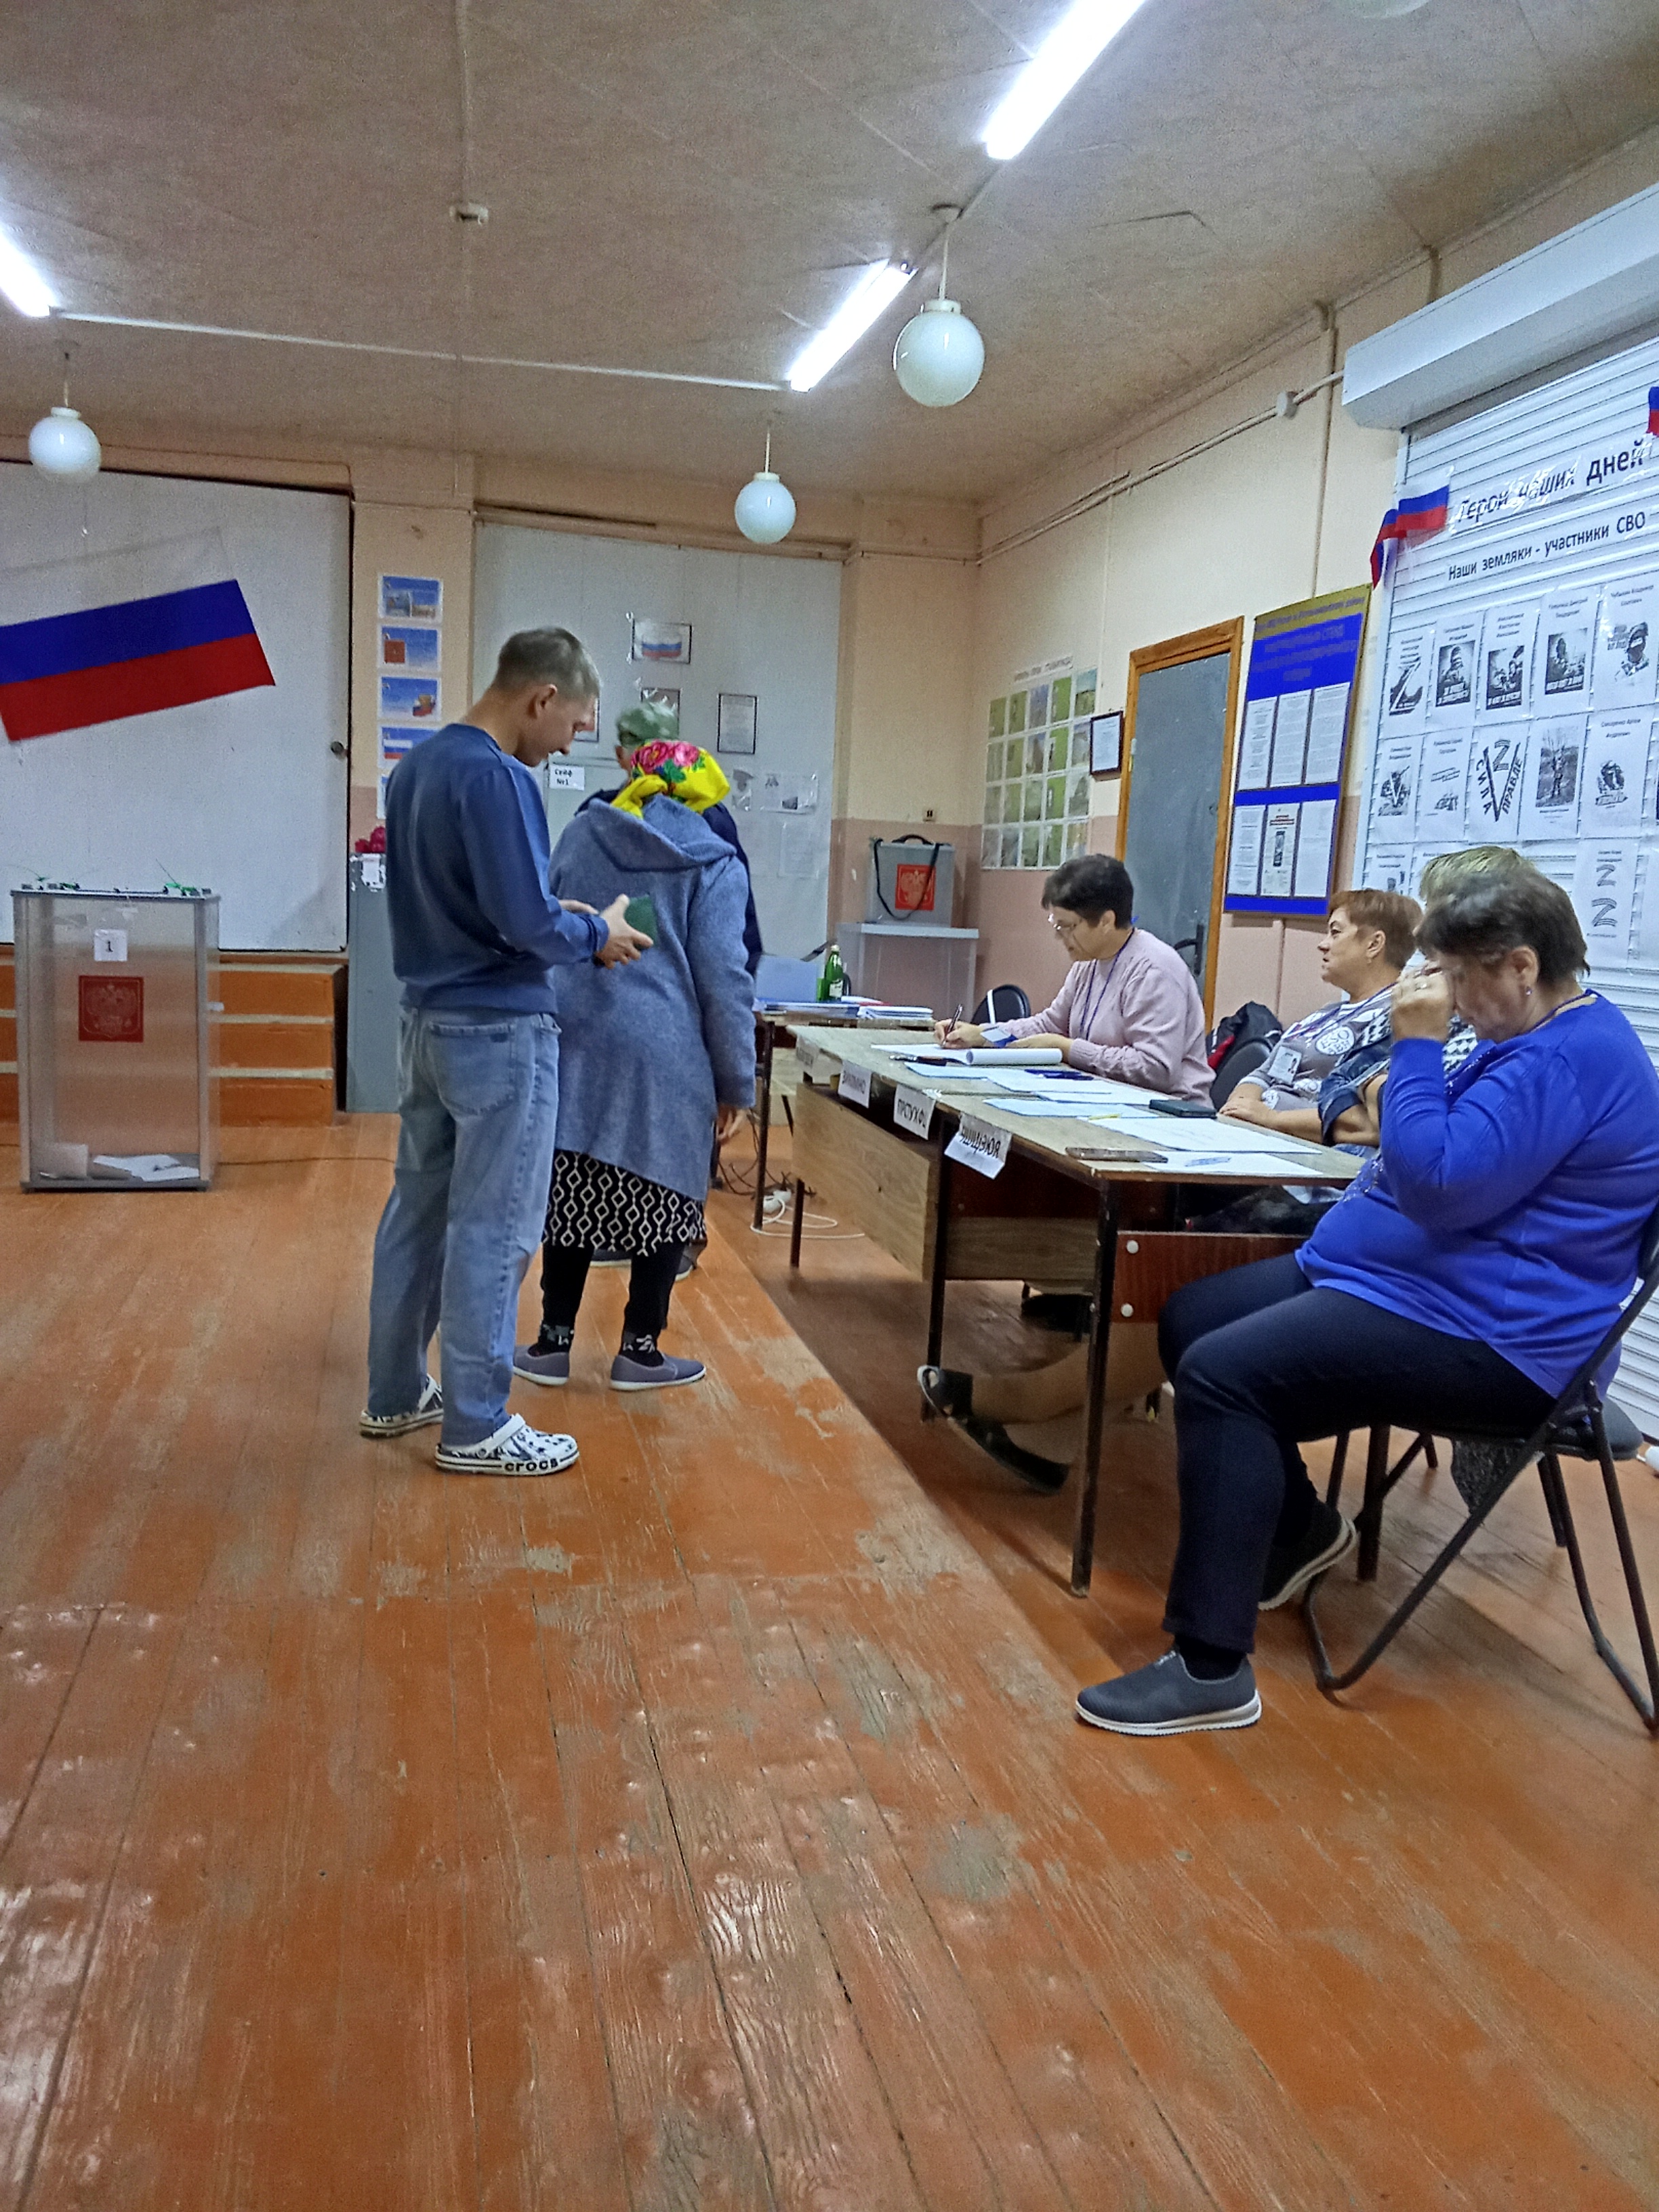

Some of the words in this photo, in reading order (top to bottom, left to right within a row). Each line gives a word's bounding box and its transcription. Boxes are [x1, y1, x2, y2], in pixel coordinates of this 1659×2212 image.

[1586, 438, 1643, 486] дней
[1448, 561, 1477, 581] Наши
[1482, 546, 1532, 571] земляки
[1545, 525, 1610, 557] участники
[1616, 512, 1645, 534] СВО
[1492, 739, 1511, 772] Z
[1476, 758, 1493, 815] СИЛА
[1502, 757, 1523, 815] ПРАВДЕ
[106, 941, 113, 952] 1
[504, 1459, 558, 1471] crocs
